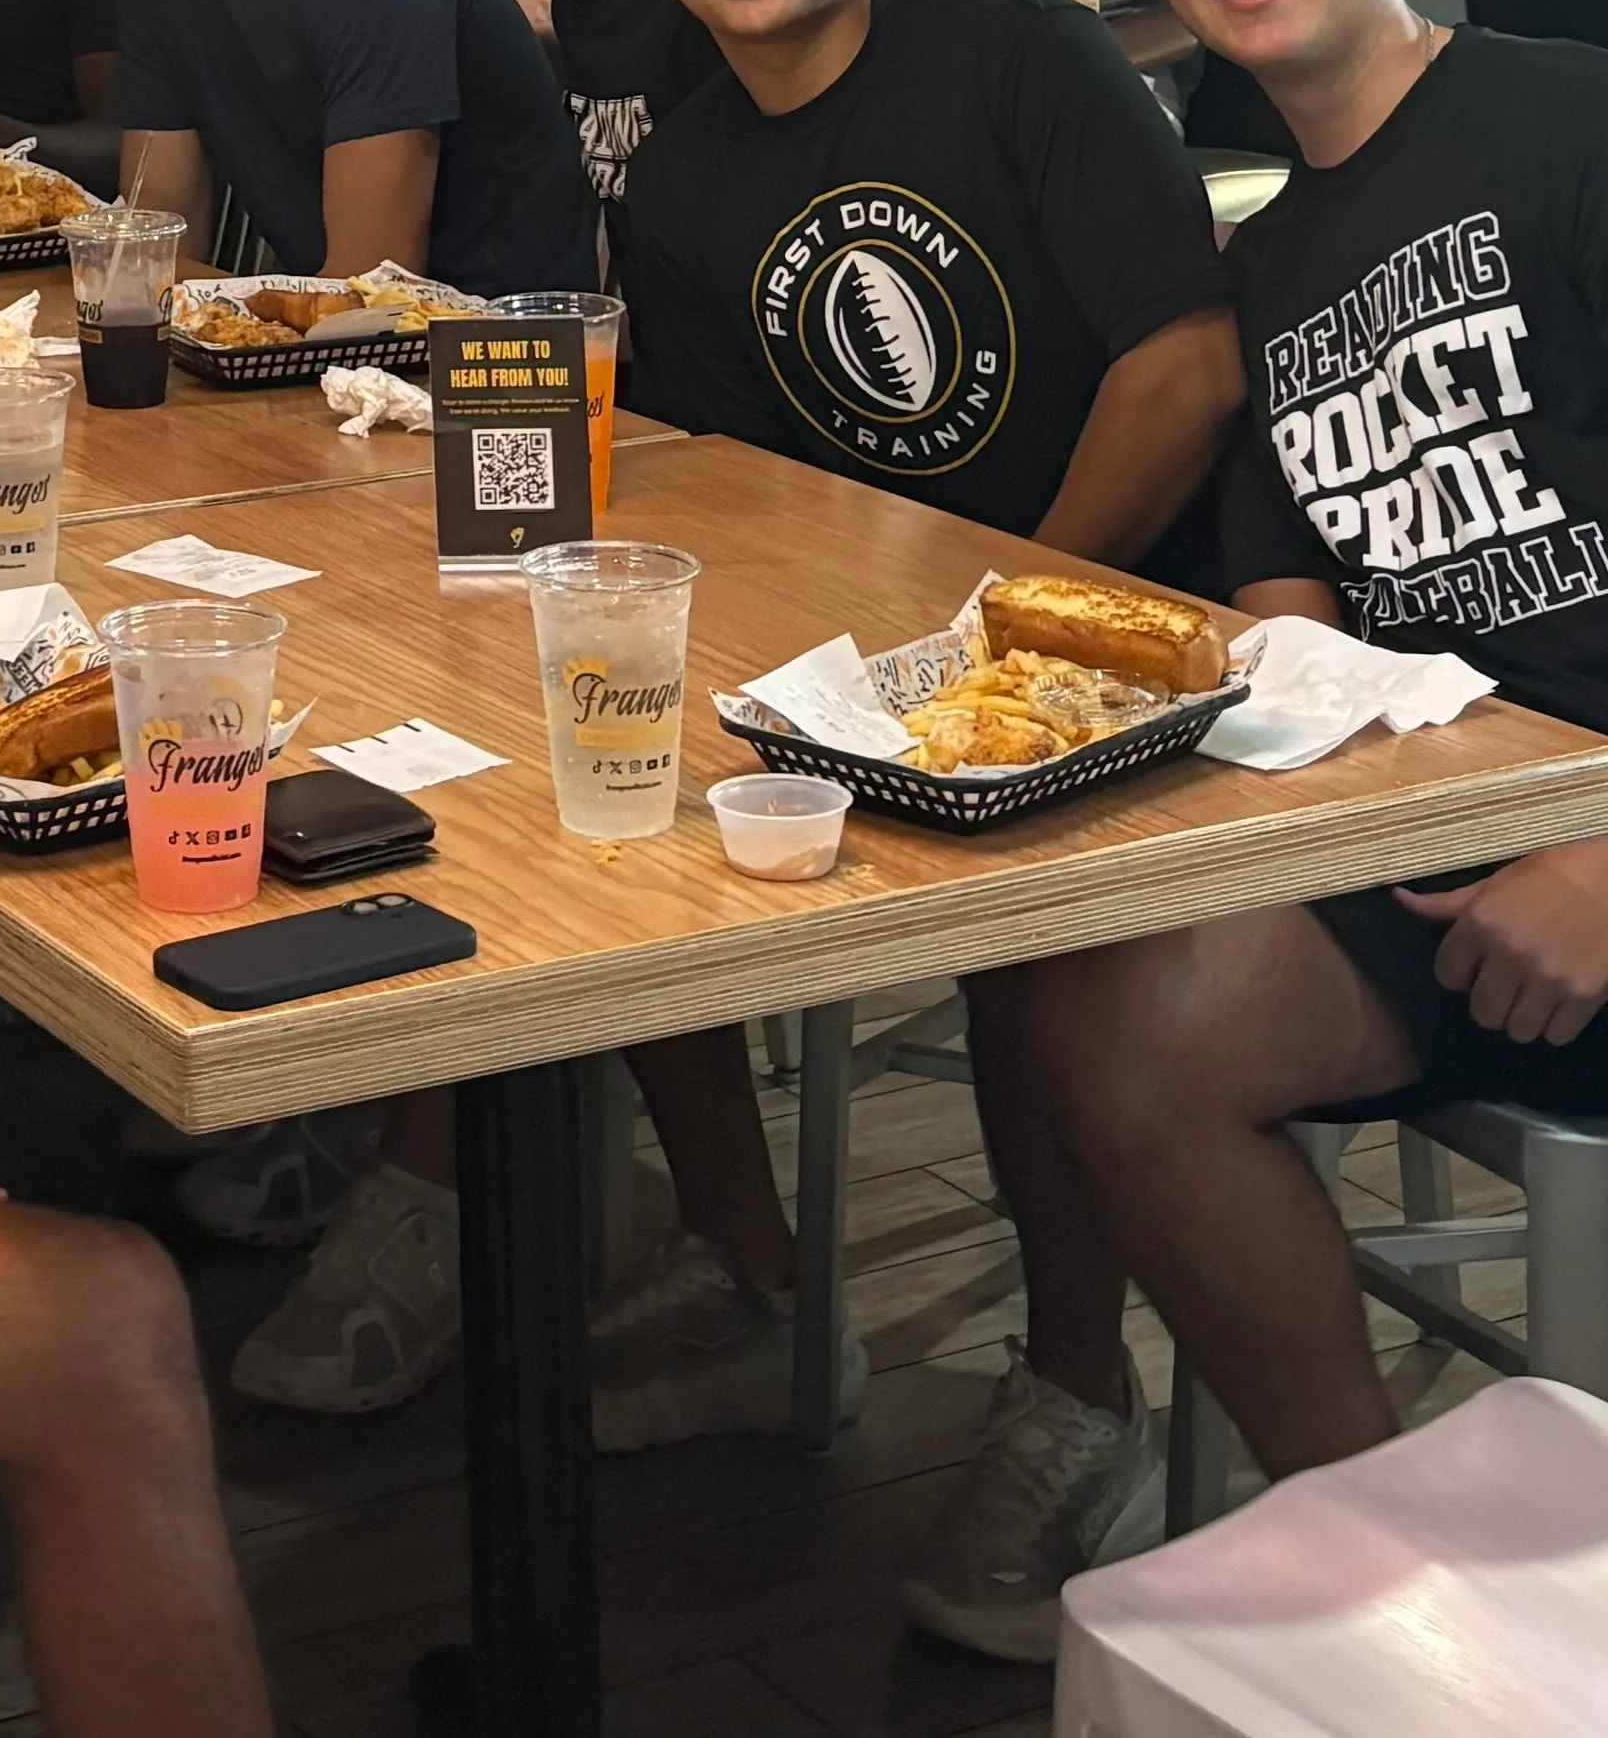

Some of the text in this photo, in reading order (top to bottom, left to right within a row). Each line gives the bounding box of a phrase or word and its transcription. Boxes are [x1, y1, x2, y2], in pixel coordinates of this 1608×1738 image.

[765, 200, 959, 337] FIRST DOWN
[1265, 210, 1511, 415] READING
[450, 367, 569, 388] HEAR FROM YOU!
[461, 340, 551, 361] WE WANT TO
[832, 349, 997, 458] TRAINING
[1271, 304, 1534, 508] ROCKET
[1306, 428, 1567, 572] PRIDE
